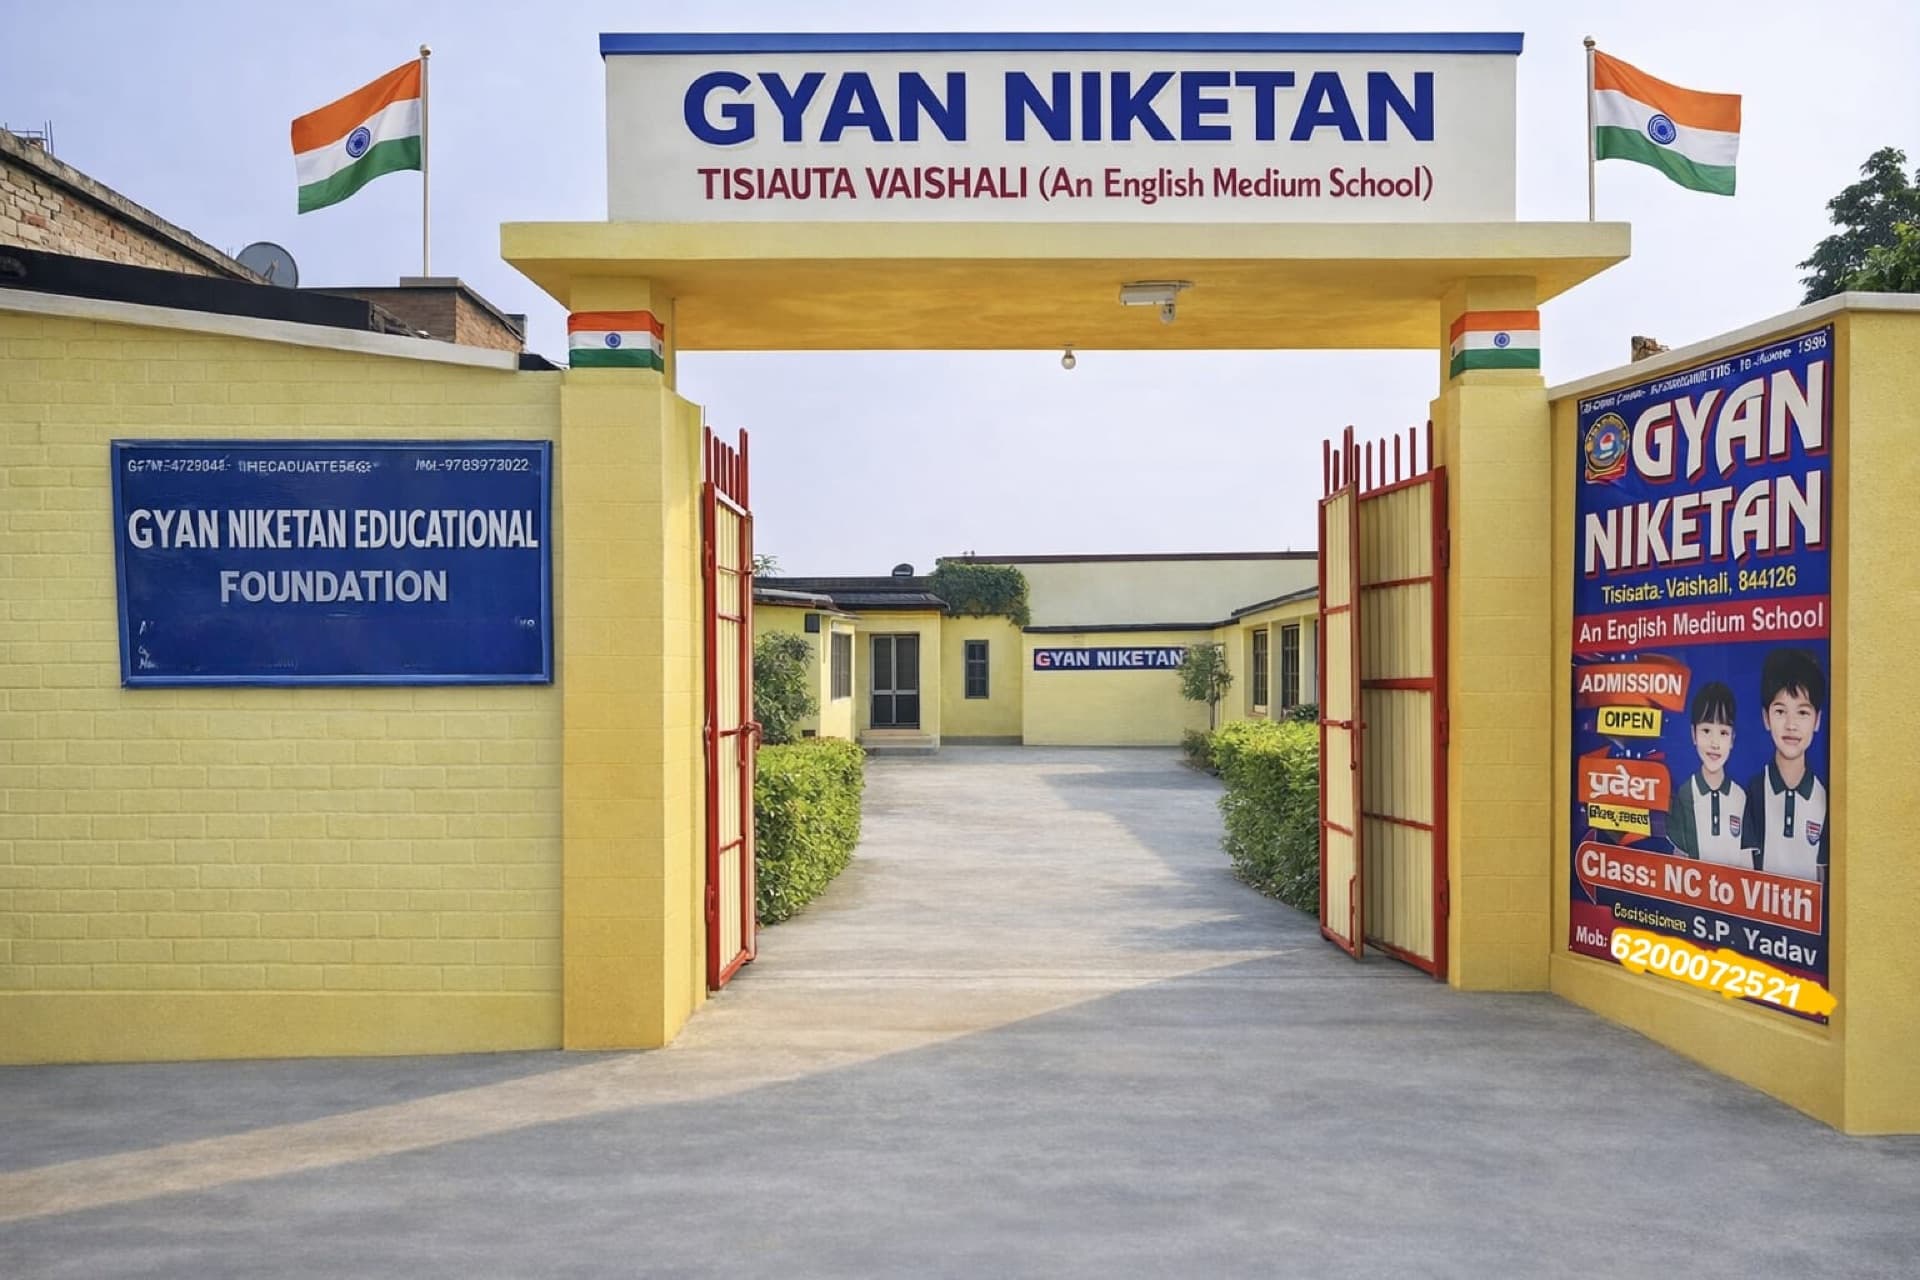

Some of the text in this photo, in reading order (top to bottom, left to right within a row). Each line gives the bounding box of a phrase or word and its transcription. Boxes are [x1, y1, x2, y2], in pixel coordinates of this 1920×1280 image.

[683, 70, 1435, 145] GYAN NIKETAN
[697, 166, 1433, 206] TISIAUTA VAISHALI (An English Medium School)
[1631, 360, 1826, 480] GYAN
[128, 508, 540, 549] GYAN NIKETAN EDUCATIONAL
[1584, 470, 1823, 575] NIKETAN
[220, 569, 448, 603] FOUNDATION
[1665, 571, 1732, 598] Vaishali,
[1738, 565, 1797, 591] 844126
[1579, 601, 1824, 645] An English Medium School
[1035, 650, 1184, 667] GYAN NIKETAN
[1579, 673, 1682, 696] ADMISSION
[1587, 764, 1661, 801] प्रवेश
[1581, 850, 1657, 888] Class:
[1664, 863, 1701, 898] NC
[1709, 873, 1735, 905] to
[1576, 925, 1608, 948] Mob:
[1743, 927, 1817, 966] Yadav
